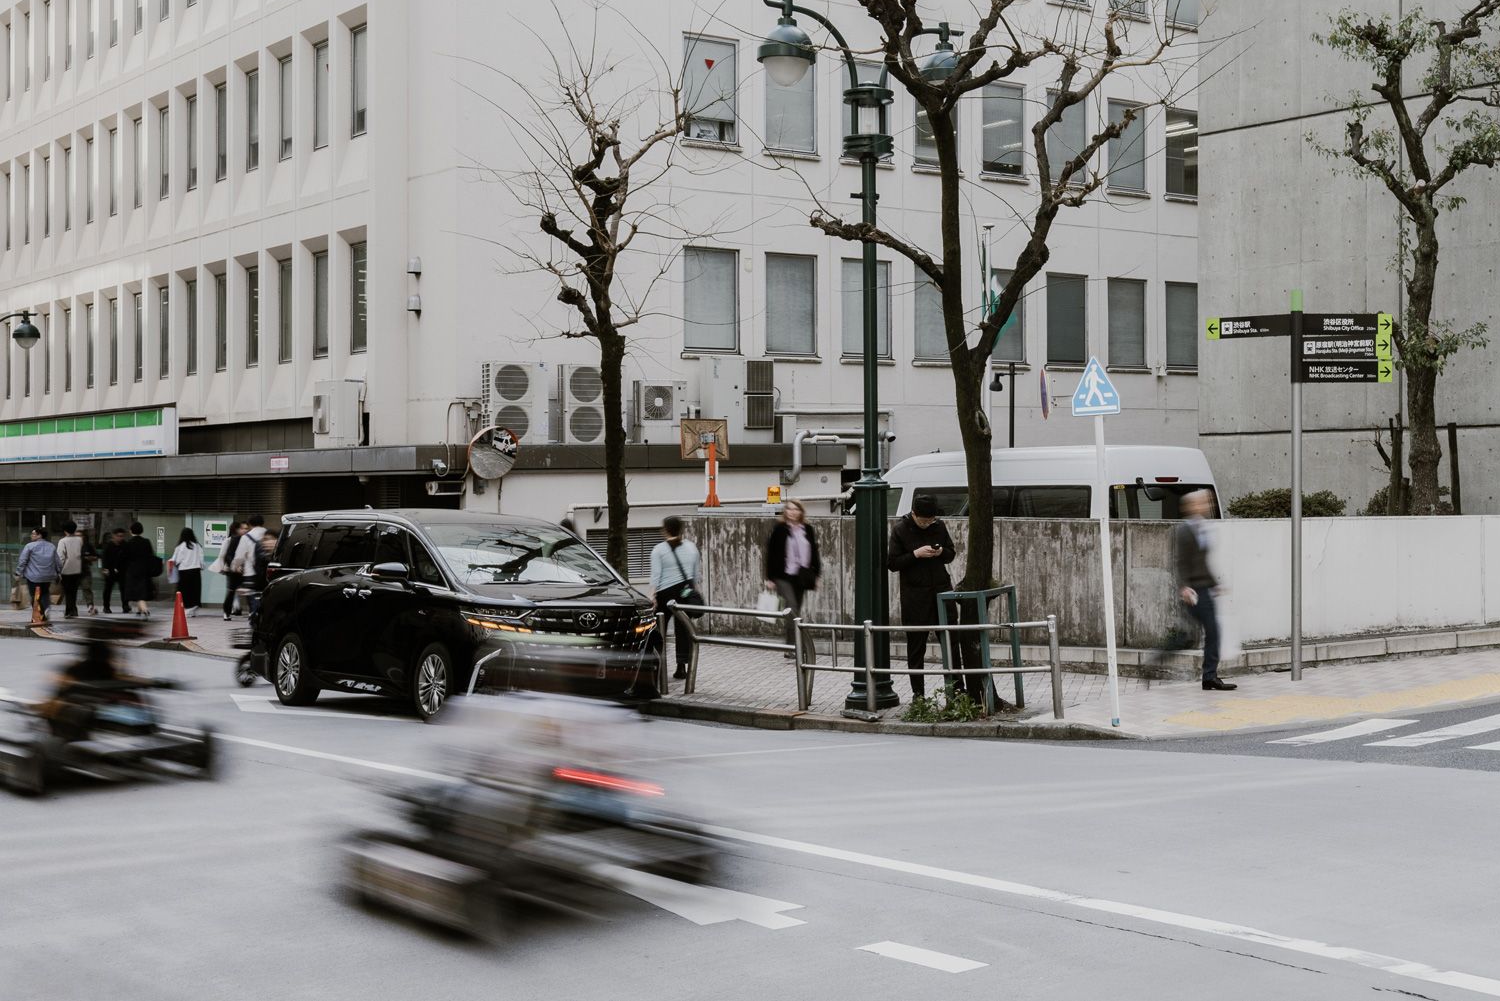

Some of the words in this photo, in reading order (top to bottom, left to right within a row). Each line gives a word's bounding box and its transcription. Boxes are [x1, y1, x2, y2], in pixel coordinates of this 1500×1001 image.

[1323, 318, 1354, 326] 渋谷区役所
